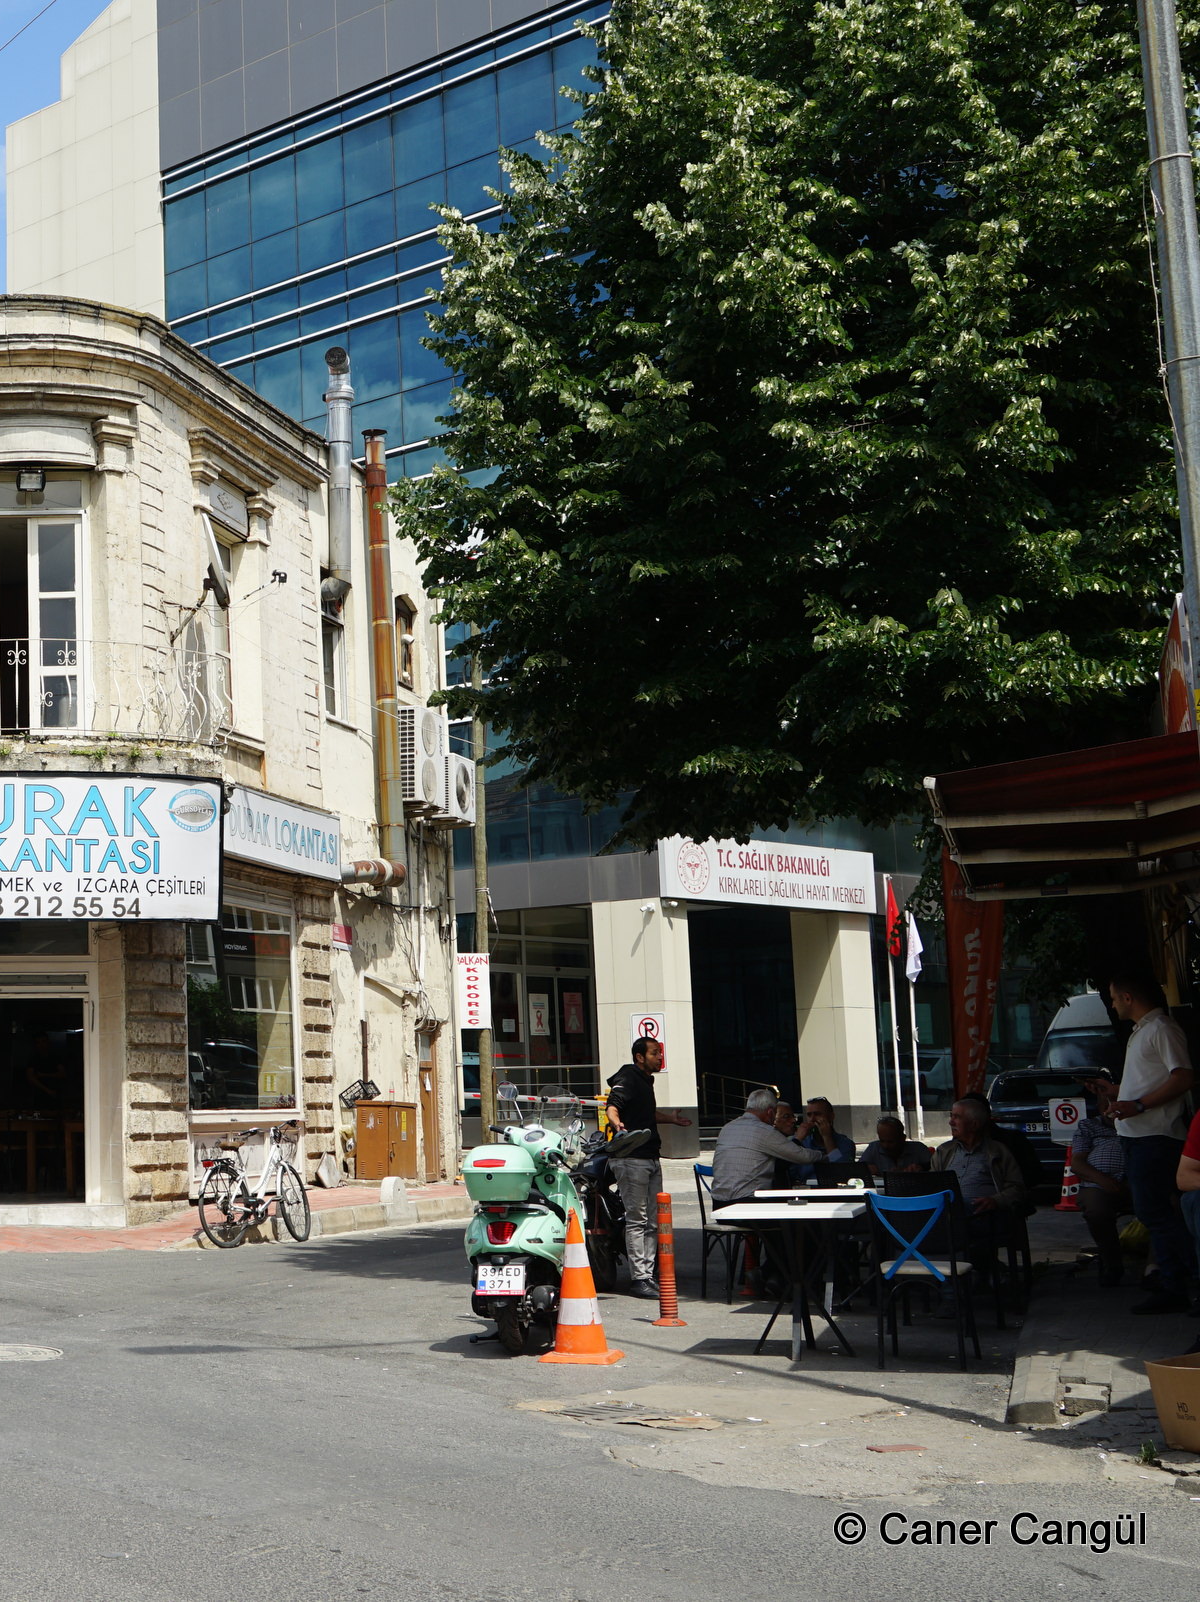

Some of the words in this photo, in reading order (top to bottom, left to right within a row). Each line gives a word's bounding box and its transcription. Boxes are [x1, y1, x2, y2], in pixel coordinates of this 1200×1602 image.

[228, 803, 271, 848] DURAK
[274, 816, 338, 866] LOKANTASI
[716, 848, 736, 868] T.C.
[738, 849, 775, 872] SAĞLIK
[777, 855, 830, 877] BAKANLIĞI
[42, 883, 63, 892] ve
[76, 877, 139, 893] IZGARA
[145, 875, 206, 897] ÇEŞİTLERİ
[718, 876, 767, 897] KIRKLARELİ
[768, 879, 805, 900] SAĞLIKLI
[806, 884, 830, 902] HAYAT
[832, 886, 866, 905] MERKEZİ
[14, 896, 63, 917] 212
[72, 897, 104, 917] 55
[111, 897, 142, 918] 54
[1026, 1123, 1037, 1131] 39
[489, 1279, 511, 1289] 371
